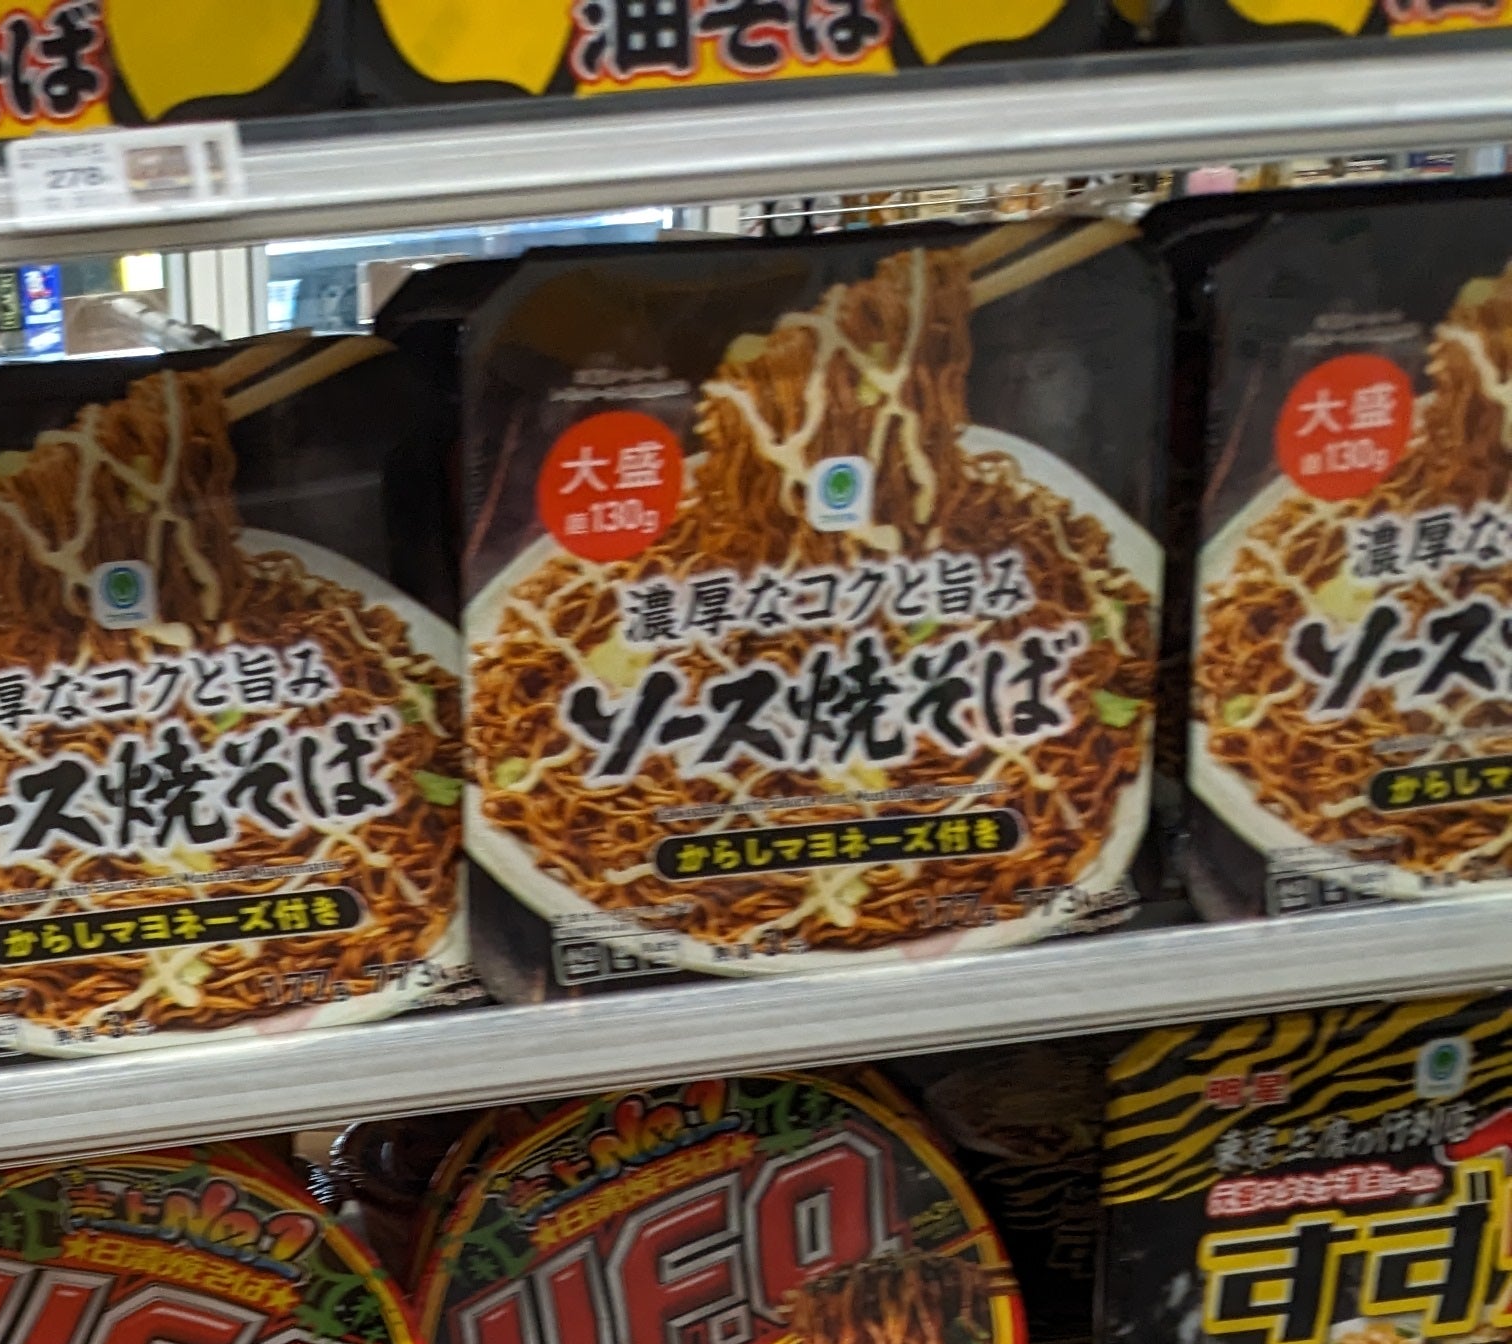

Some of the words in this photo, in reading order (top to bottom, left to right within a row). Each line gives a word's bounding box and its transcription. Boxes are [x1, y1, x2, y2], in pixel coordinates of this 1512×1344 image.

[573, 0, 889, 77] 油そば
[1296, 382, 1397, 437] 大盛
[559, 441, 664, 494] 大盛
[626, 554, 1027, 642] 濃厚なコクと旨み
[566, 630, 1081, 779] ソース焼そば
[677, 812, 1001, 872] からしマヨネーズ付き
[2, 895, 340, 961] からしマヨネーズ付き
[1204, 1071, 1290, 1108] 明星
